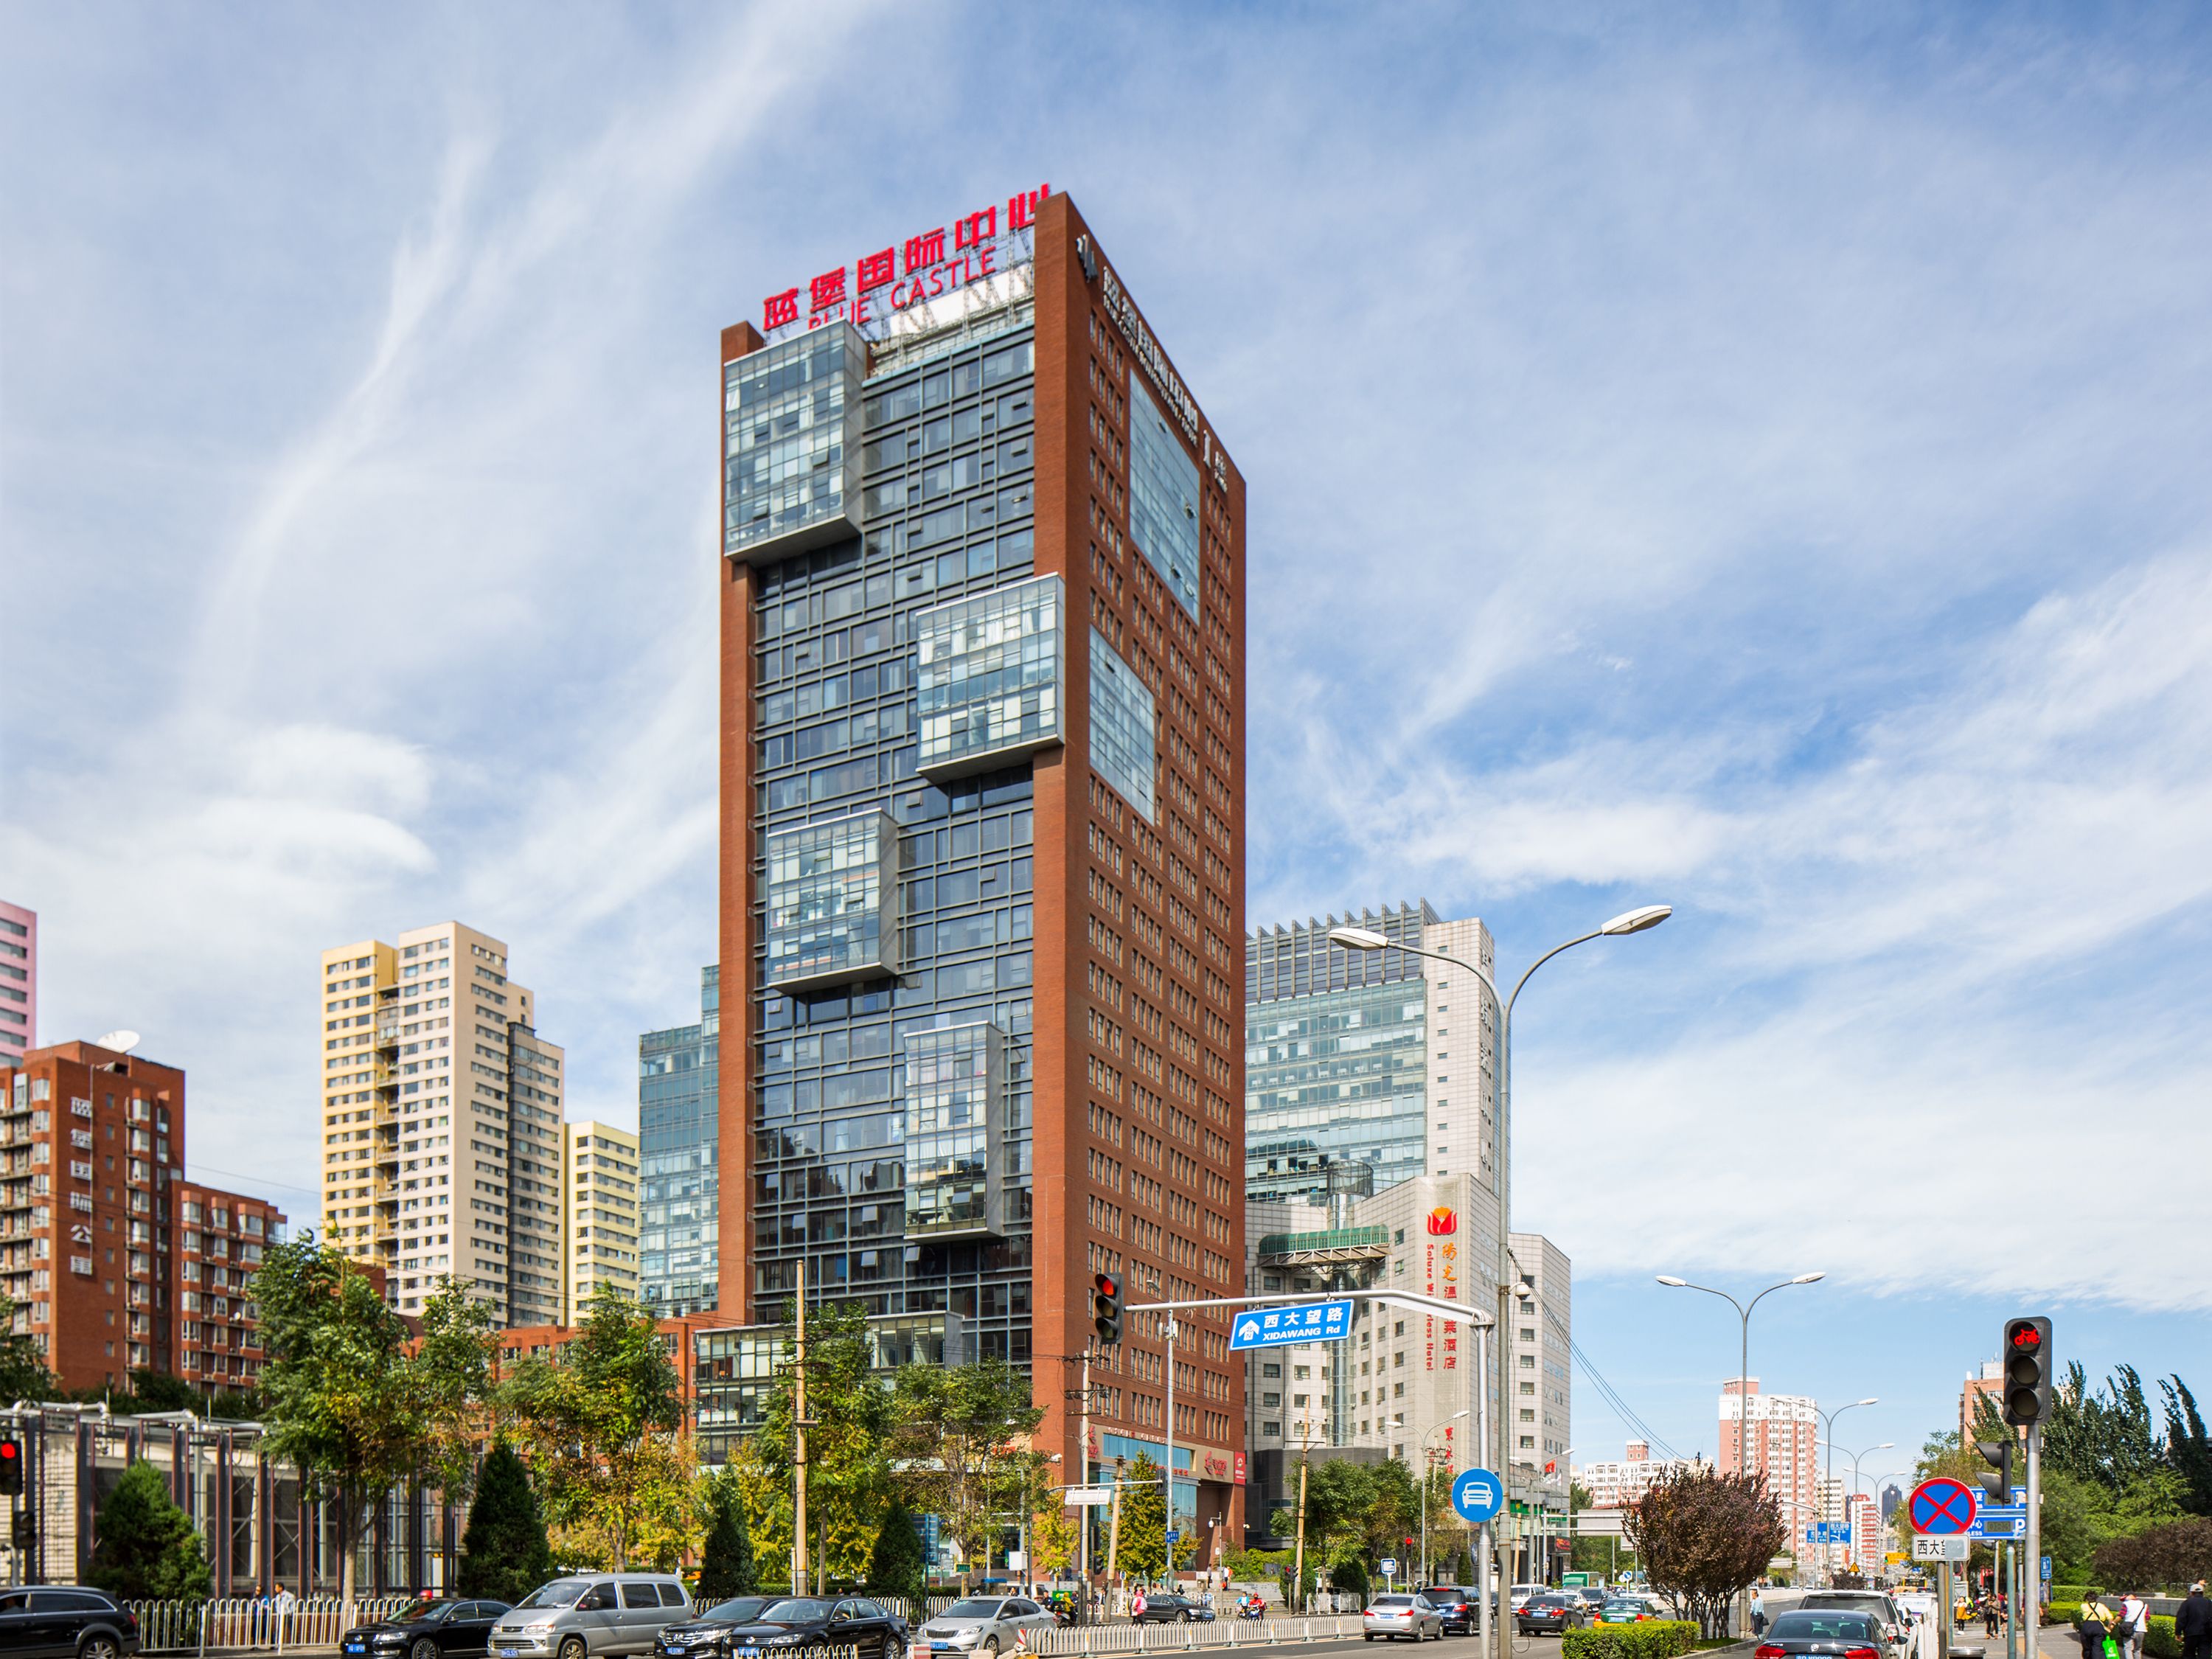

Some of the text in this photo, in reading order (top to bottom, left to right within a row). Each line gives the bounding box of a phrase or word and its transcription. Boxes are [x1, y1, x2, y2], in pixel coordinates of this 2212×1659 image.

[891, 246, 996, 310] CASTLE
[1264, 1307, 1343, 1329] 西大望路
[1262, 1326, 1340, 1341] XIDAWANG Rd
